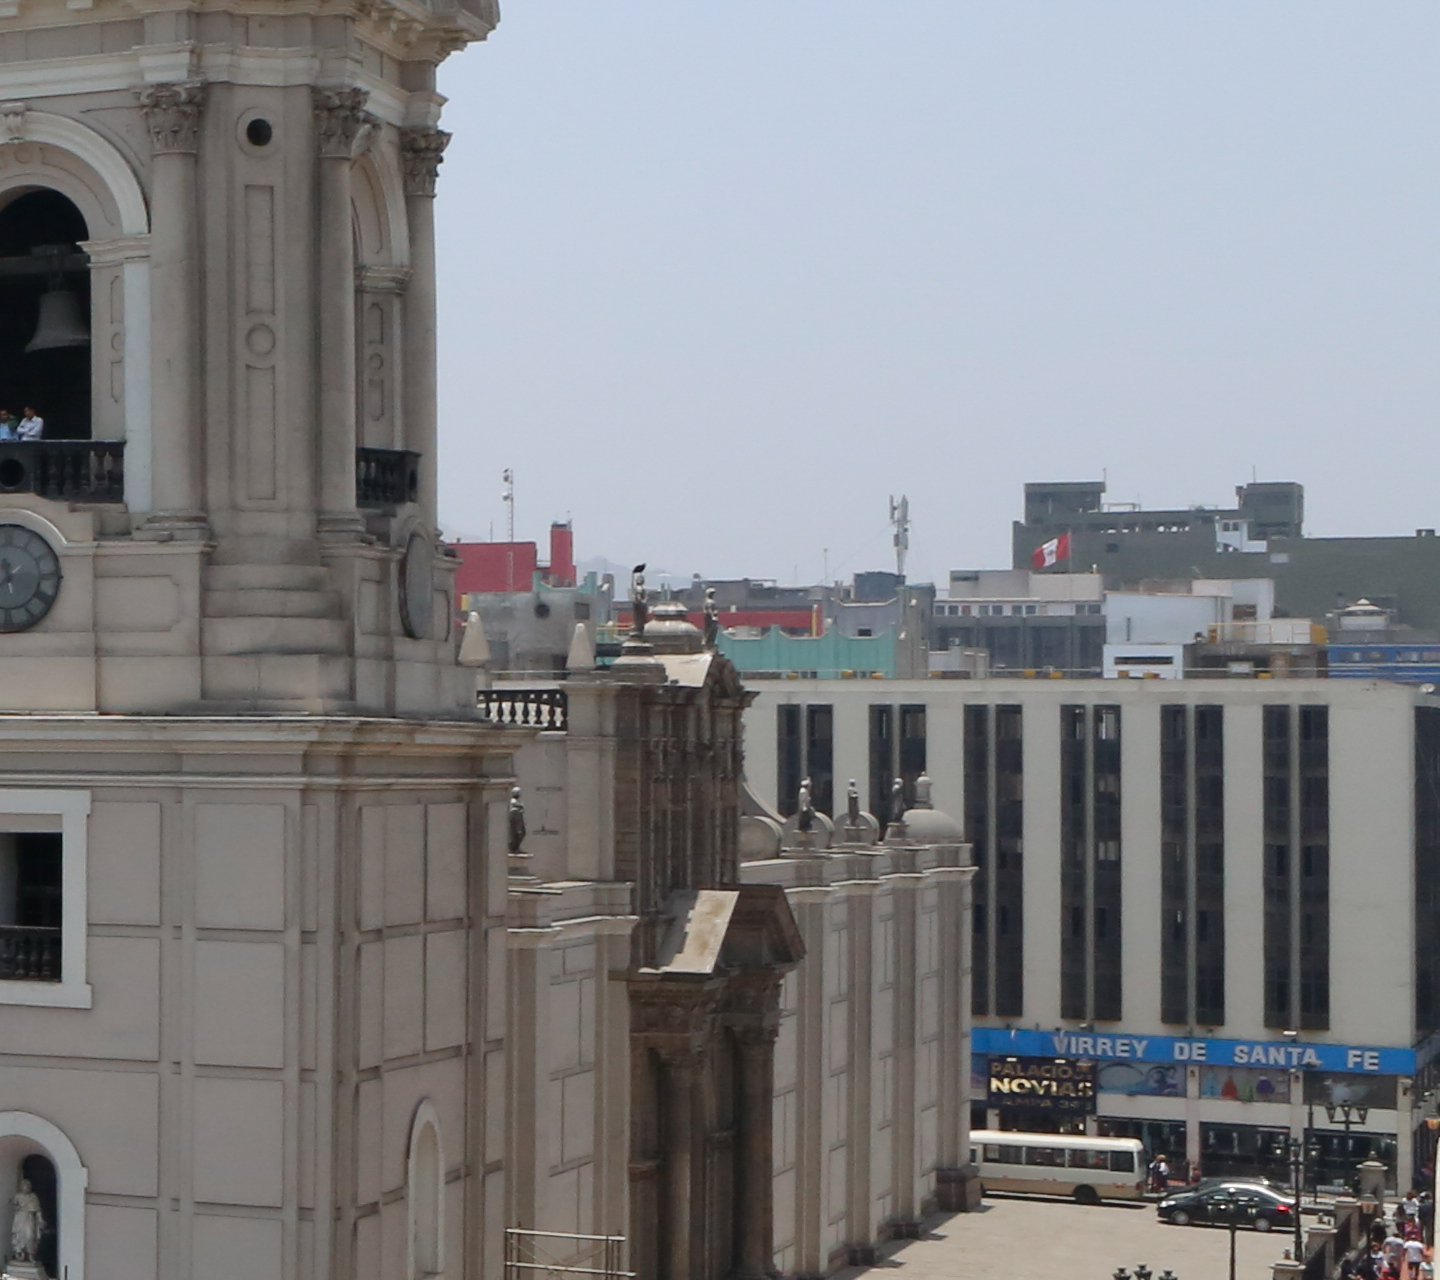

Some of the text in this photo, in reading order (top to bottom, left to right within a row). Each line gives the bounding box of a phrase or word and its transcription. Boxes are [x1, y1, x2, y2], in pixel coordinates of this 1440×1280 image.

[1053, 1036, 1379, 1070] VIRREY DE SANTA FE
[990, 1062, 1073, 1078] PALACIO
[990, 1077, 1094, 1098] NOVIAS
